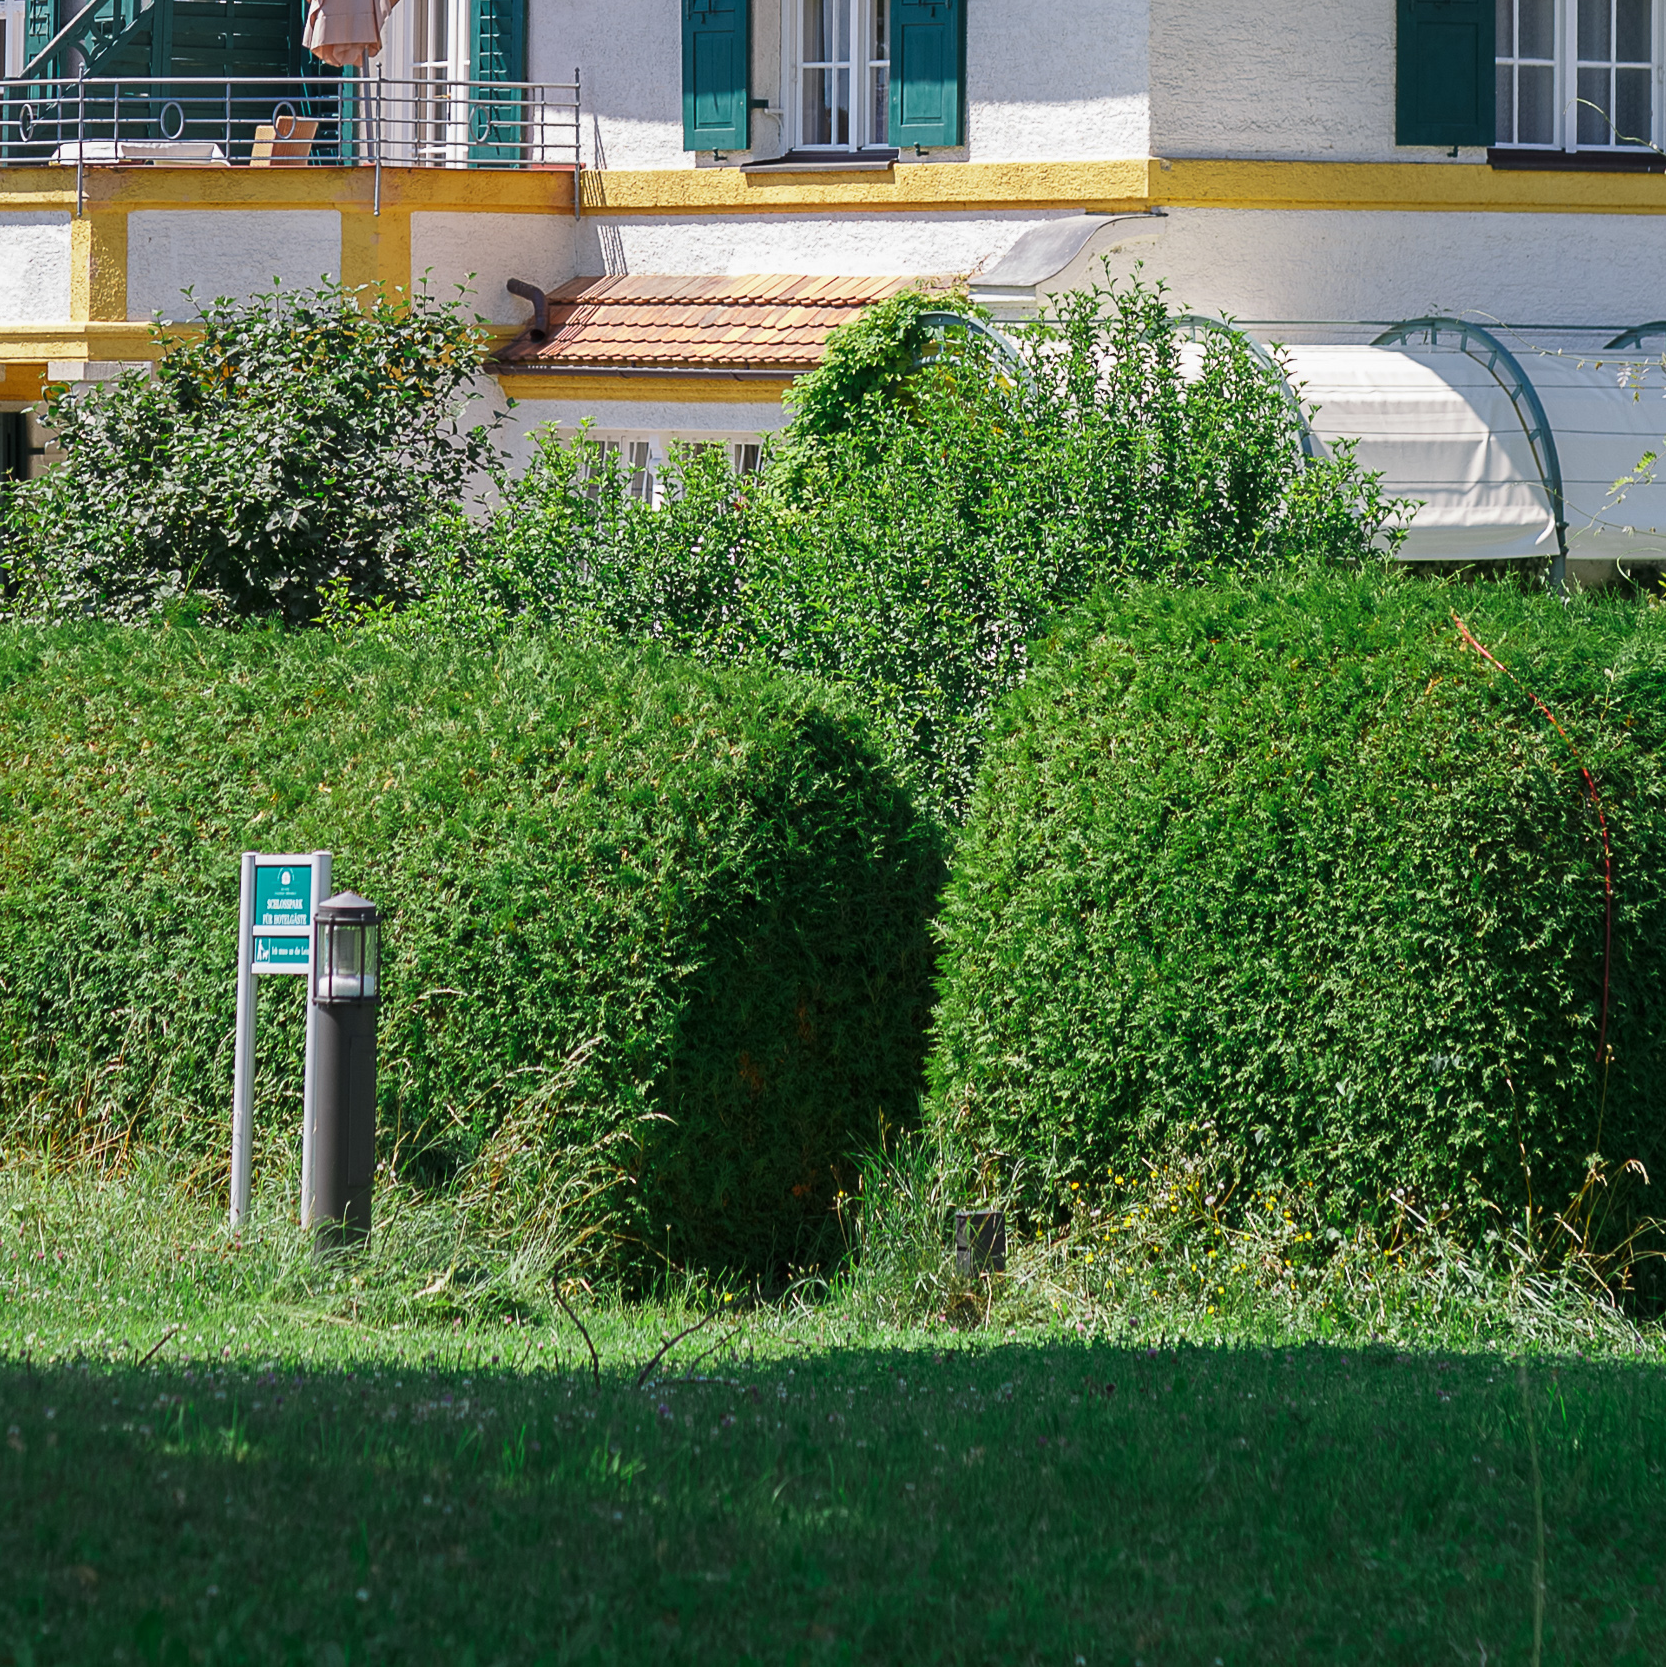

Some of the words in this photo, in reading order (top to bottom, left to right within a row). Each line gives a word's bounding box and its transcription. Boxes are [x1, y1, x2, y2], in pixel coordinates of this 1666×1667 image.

[267, 898, 303, 910] SCHLOSSPARK
[263, 912, 273, 924] FÜR
[274, 912, 307, 924] HOTELGÄSTE
